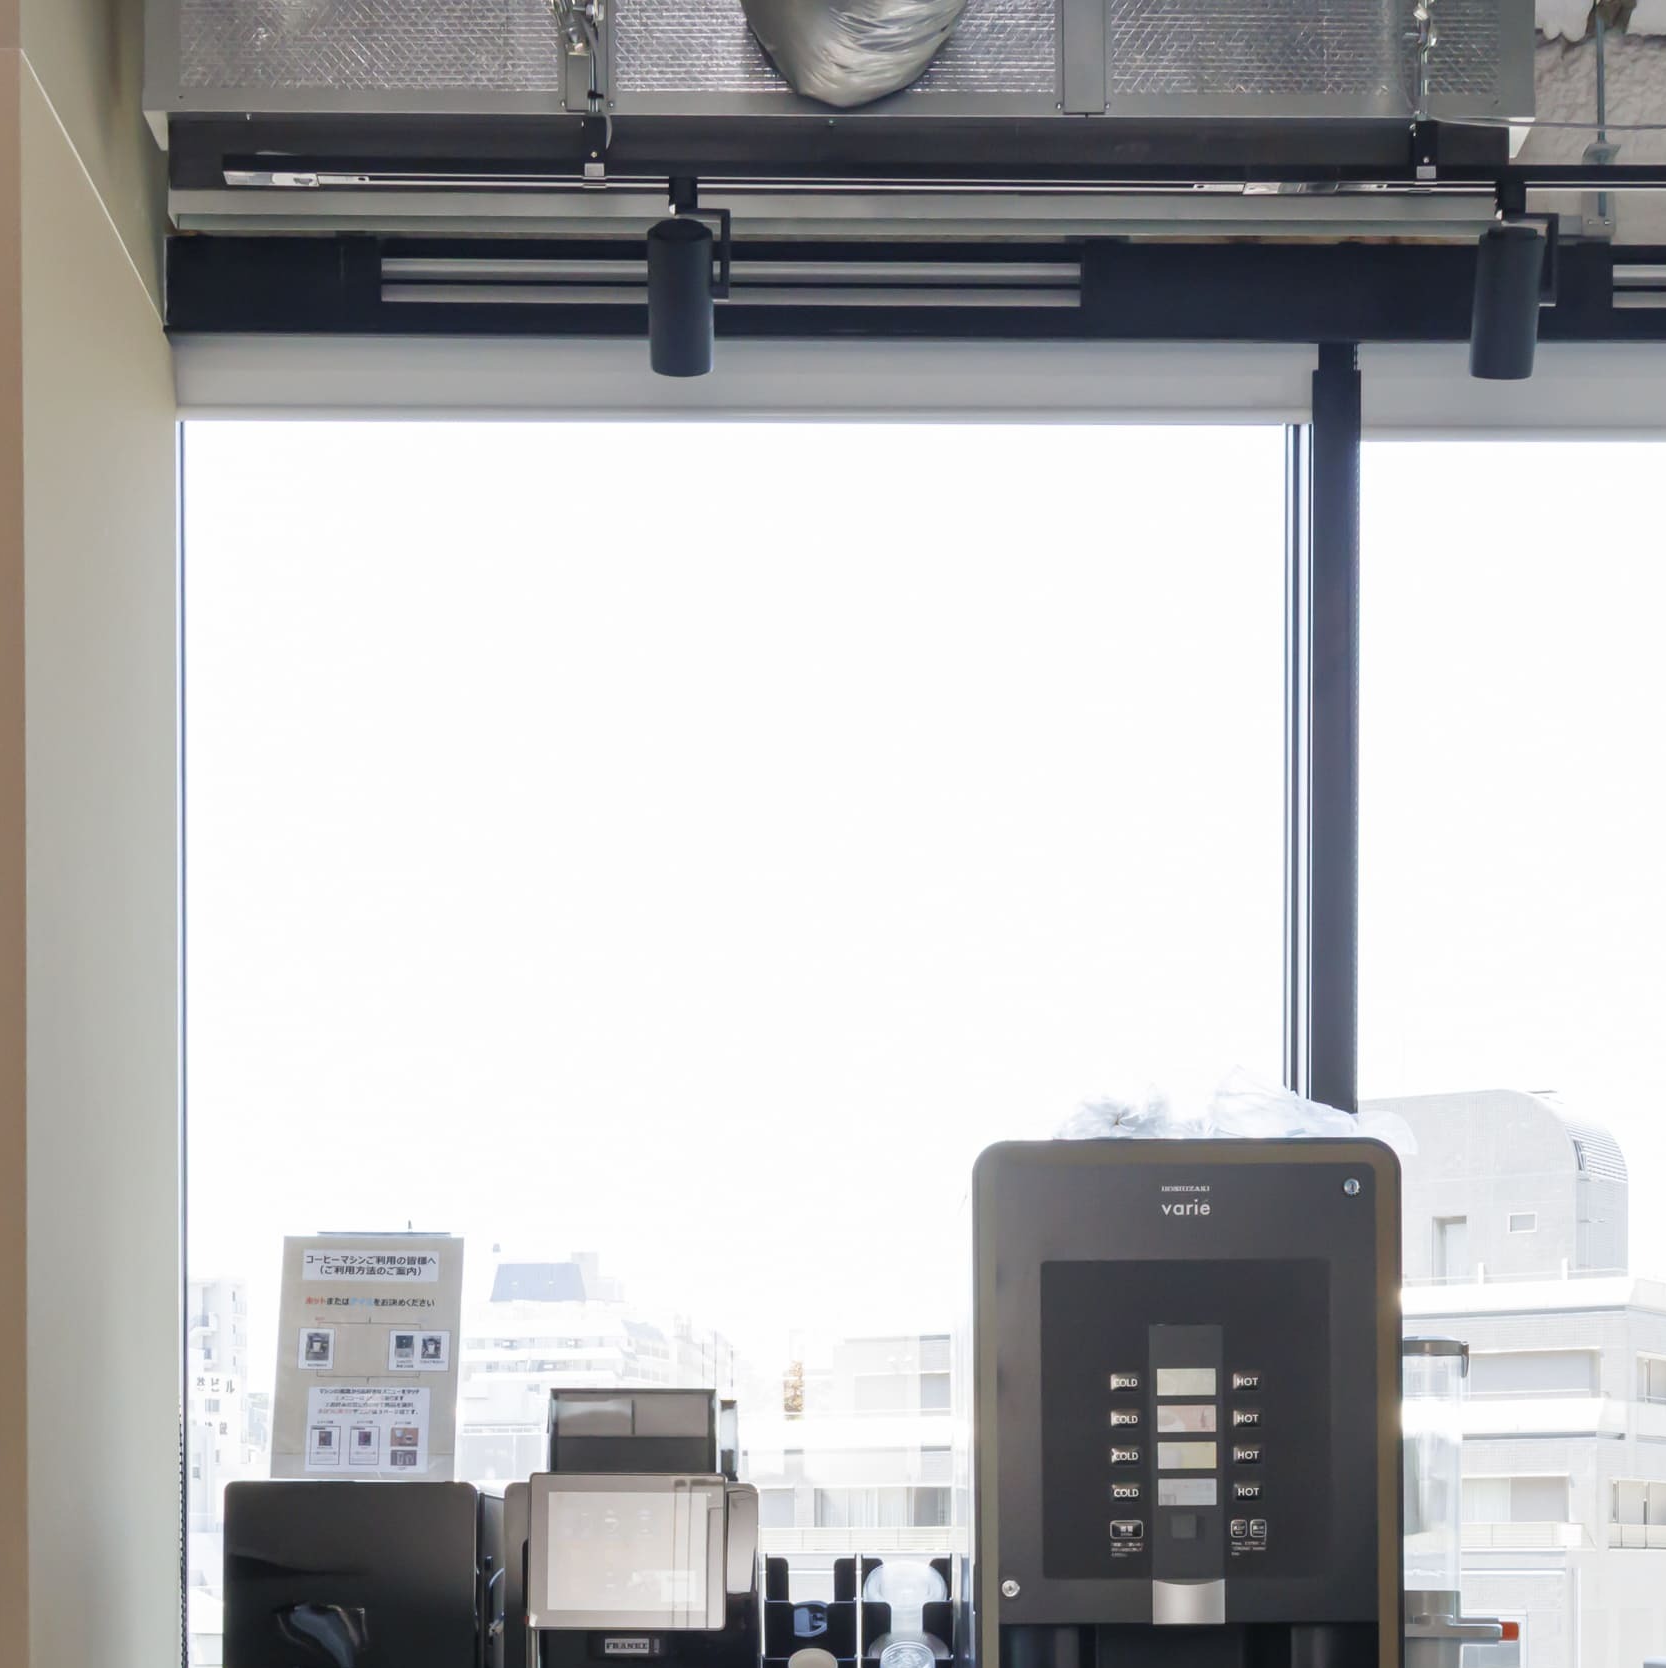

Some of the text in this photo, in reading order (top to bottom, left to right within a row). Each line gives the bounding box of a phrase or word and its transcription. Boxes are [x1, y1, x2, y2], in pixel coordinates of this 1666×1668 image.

[1114, 1378, 1138, 1388] COLD
[1236, 1377, 1259, 1386] HOT
[1114, 1415, 1139, 1424] COLD
[1236, 1414, 1259, 1423] HOT
[1114, 1451, 1139, 1461] COLD
[1237, 1450, 1260, 1460] HOT
[1113, 1488, 1140, 1498] COLD
[1237, 1487, 1260, 1497] HOT
